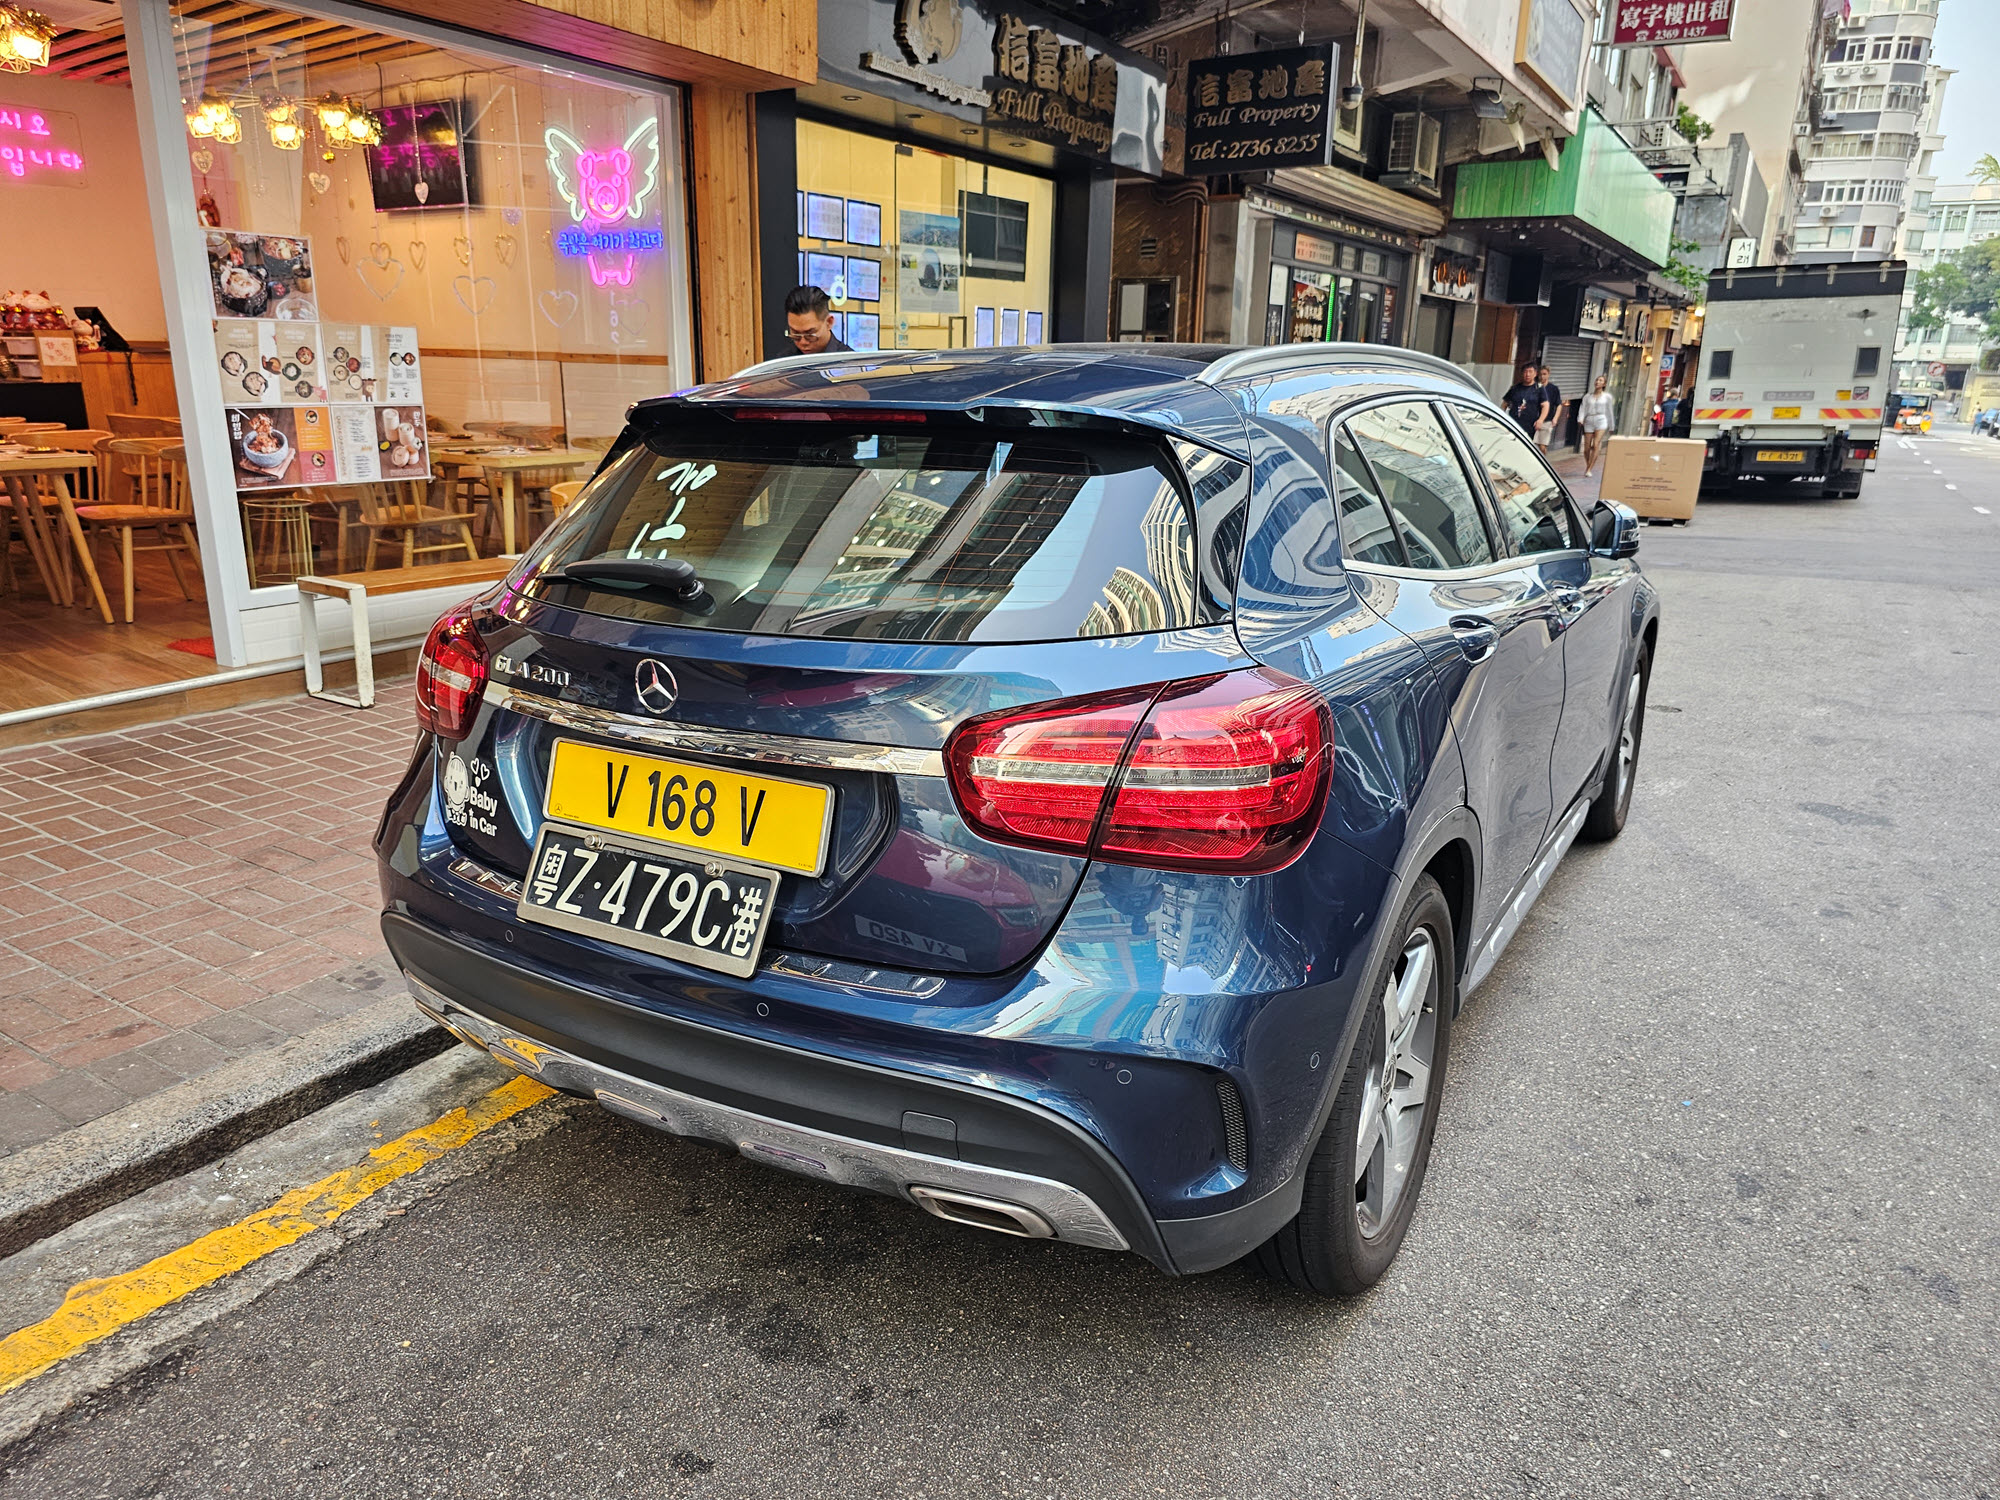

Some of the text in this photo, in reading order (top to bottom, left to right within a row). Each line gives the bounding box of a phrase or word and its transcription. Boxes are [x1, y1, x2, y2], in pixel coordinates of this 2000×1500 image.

[1620, 0, 1729, 30] 寫字樓出租
[1655, 26, 1708, 40] 2369 1437
[999, 87, 1112, 153] Full Property
[1193, 103, 1321, 129] Full Property
[1273, 133, 1321, 154] 8255
[592, 233, 625, 249] 여기가
[470, 786, 497, 818] Baby
[607, 762, 767, 847] V 168 V
[469, 807, 498, 837] in Car
